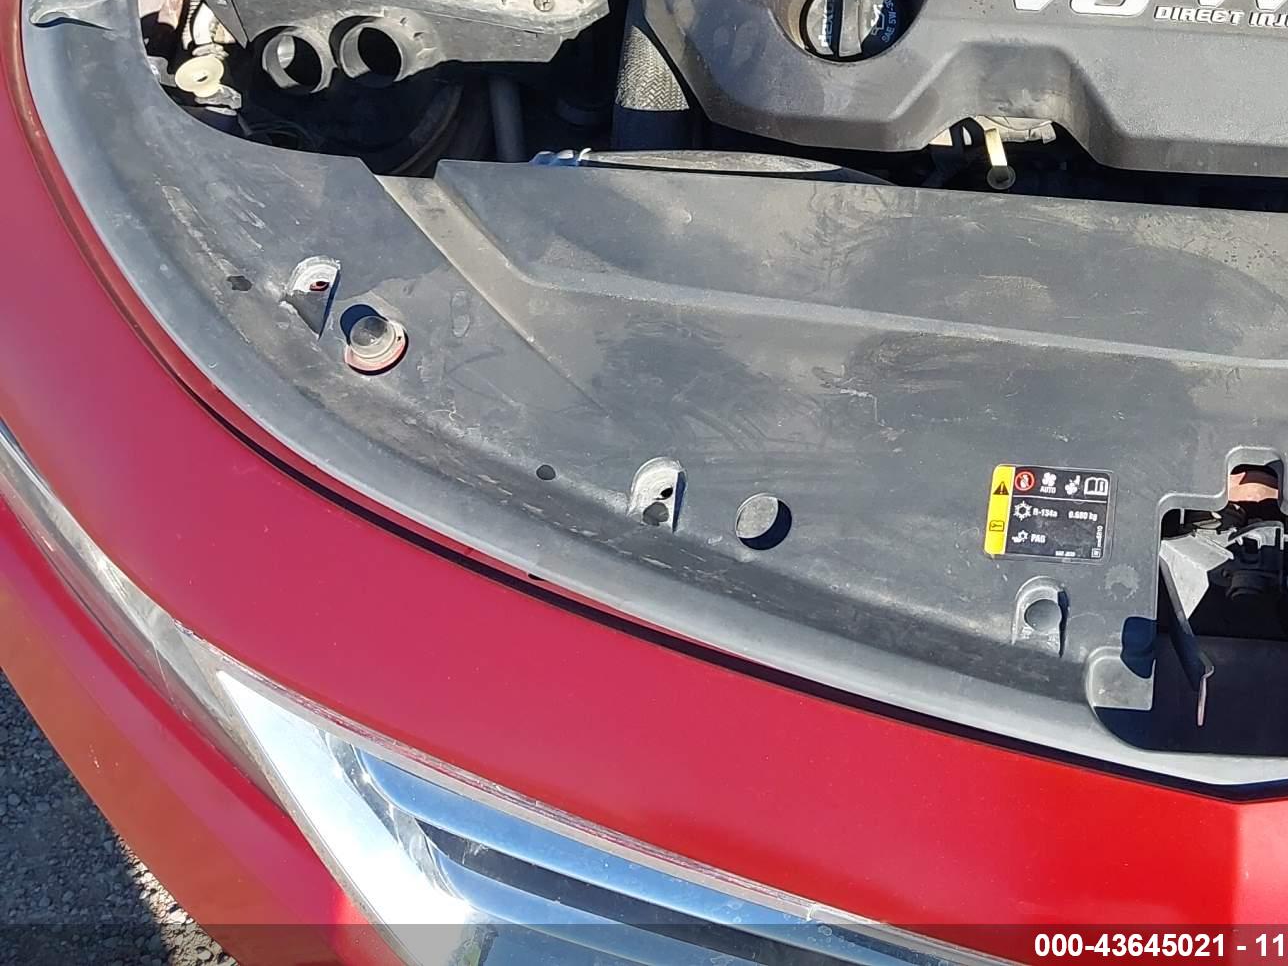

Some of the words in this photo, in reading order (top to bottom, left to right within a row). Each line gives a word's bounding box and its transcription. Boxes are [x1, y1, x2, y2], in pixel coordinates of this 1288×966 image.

[1154, 6, 1244, 25] DIRECT
[1040, 486, 1057, 494] AUTO
[1088, 512, 1098, 522] kg
